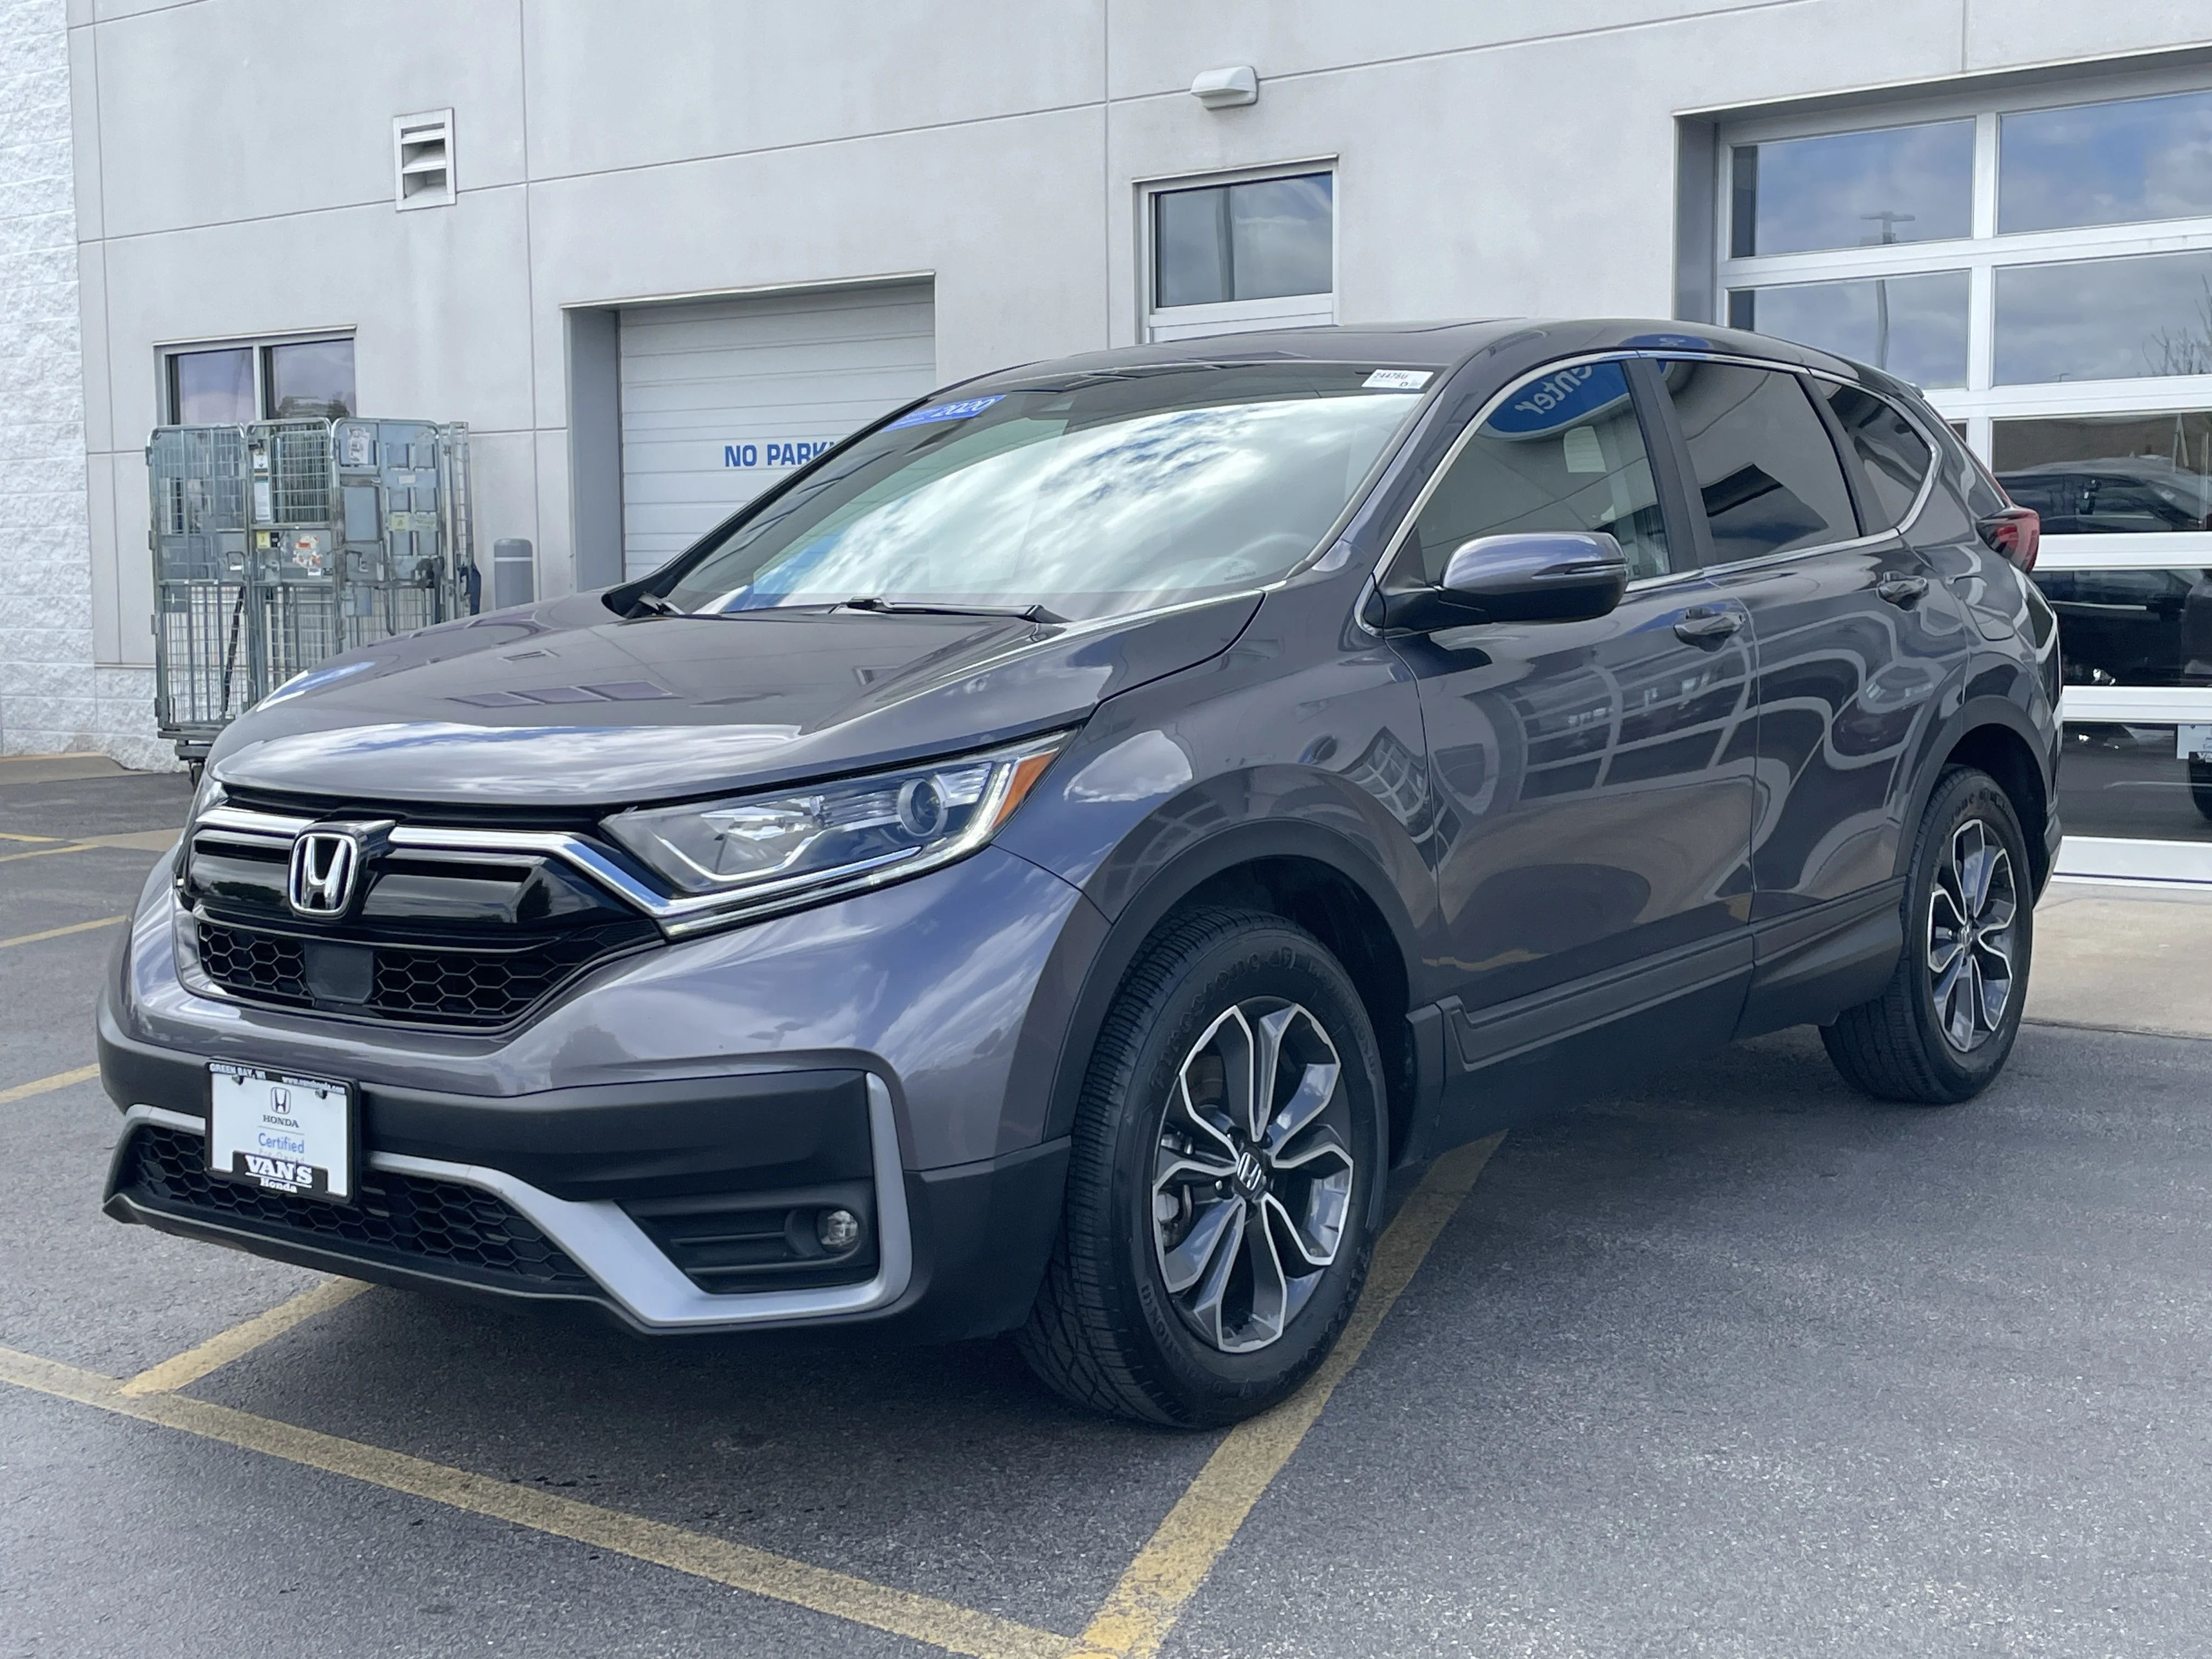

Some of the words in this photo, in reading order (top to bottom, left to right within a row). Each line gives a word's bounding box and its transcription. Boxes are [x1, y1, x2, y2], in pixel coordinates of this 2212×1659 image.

[725, 445, 757, 467] NO
[767, 442, 836, 466] PARK
[210, 1063, 236, 1074] GREEN
[263, 1114, 300, 1128] HONDA
[258, 1132, 304, 1154] Certified
[259, 1177, 297, 1193] Honda
